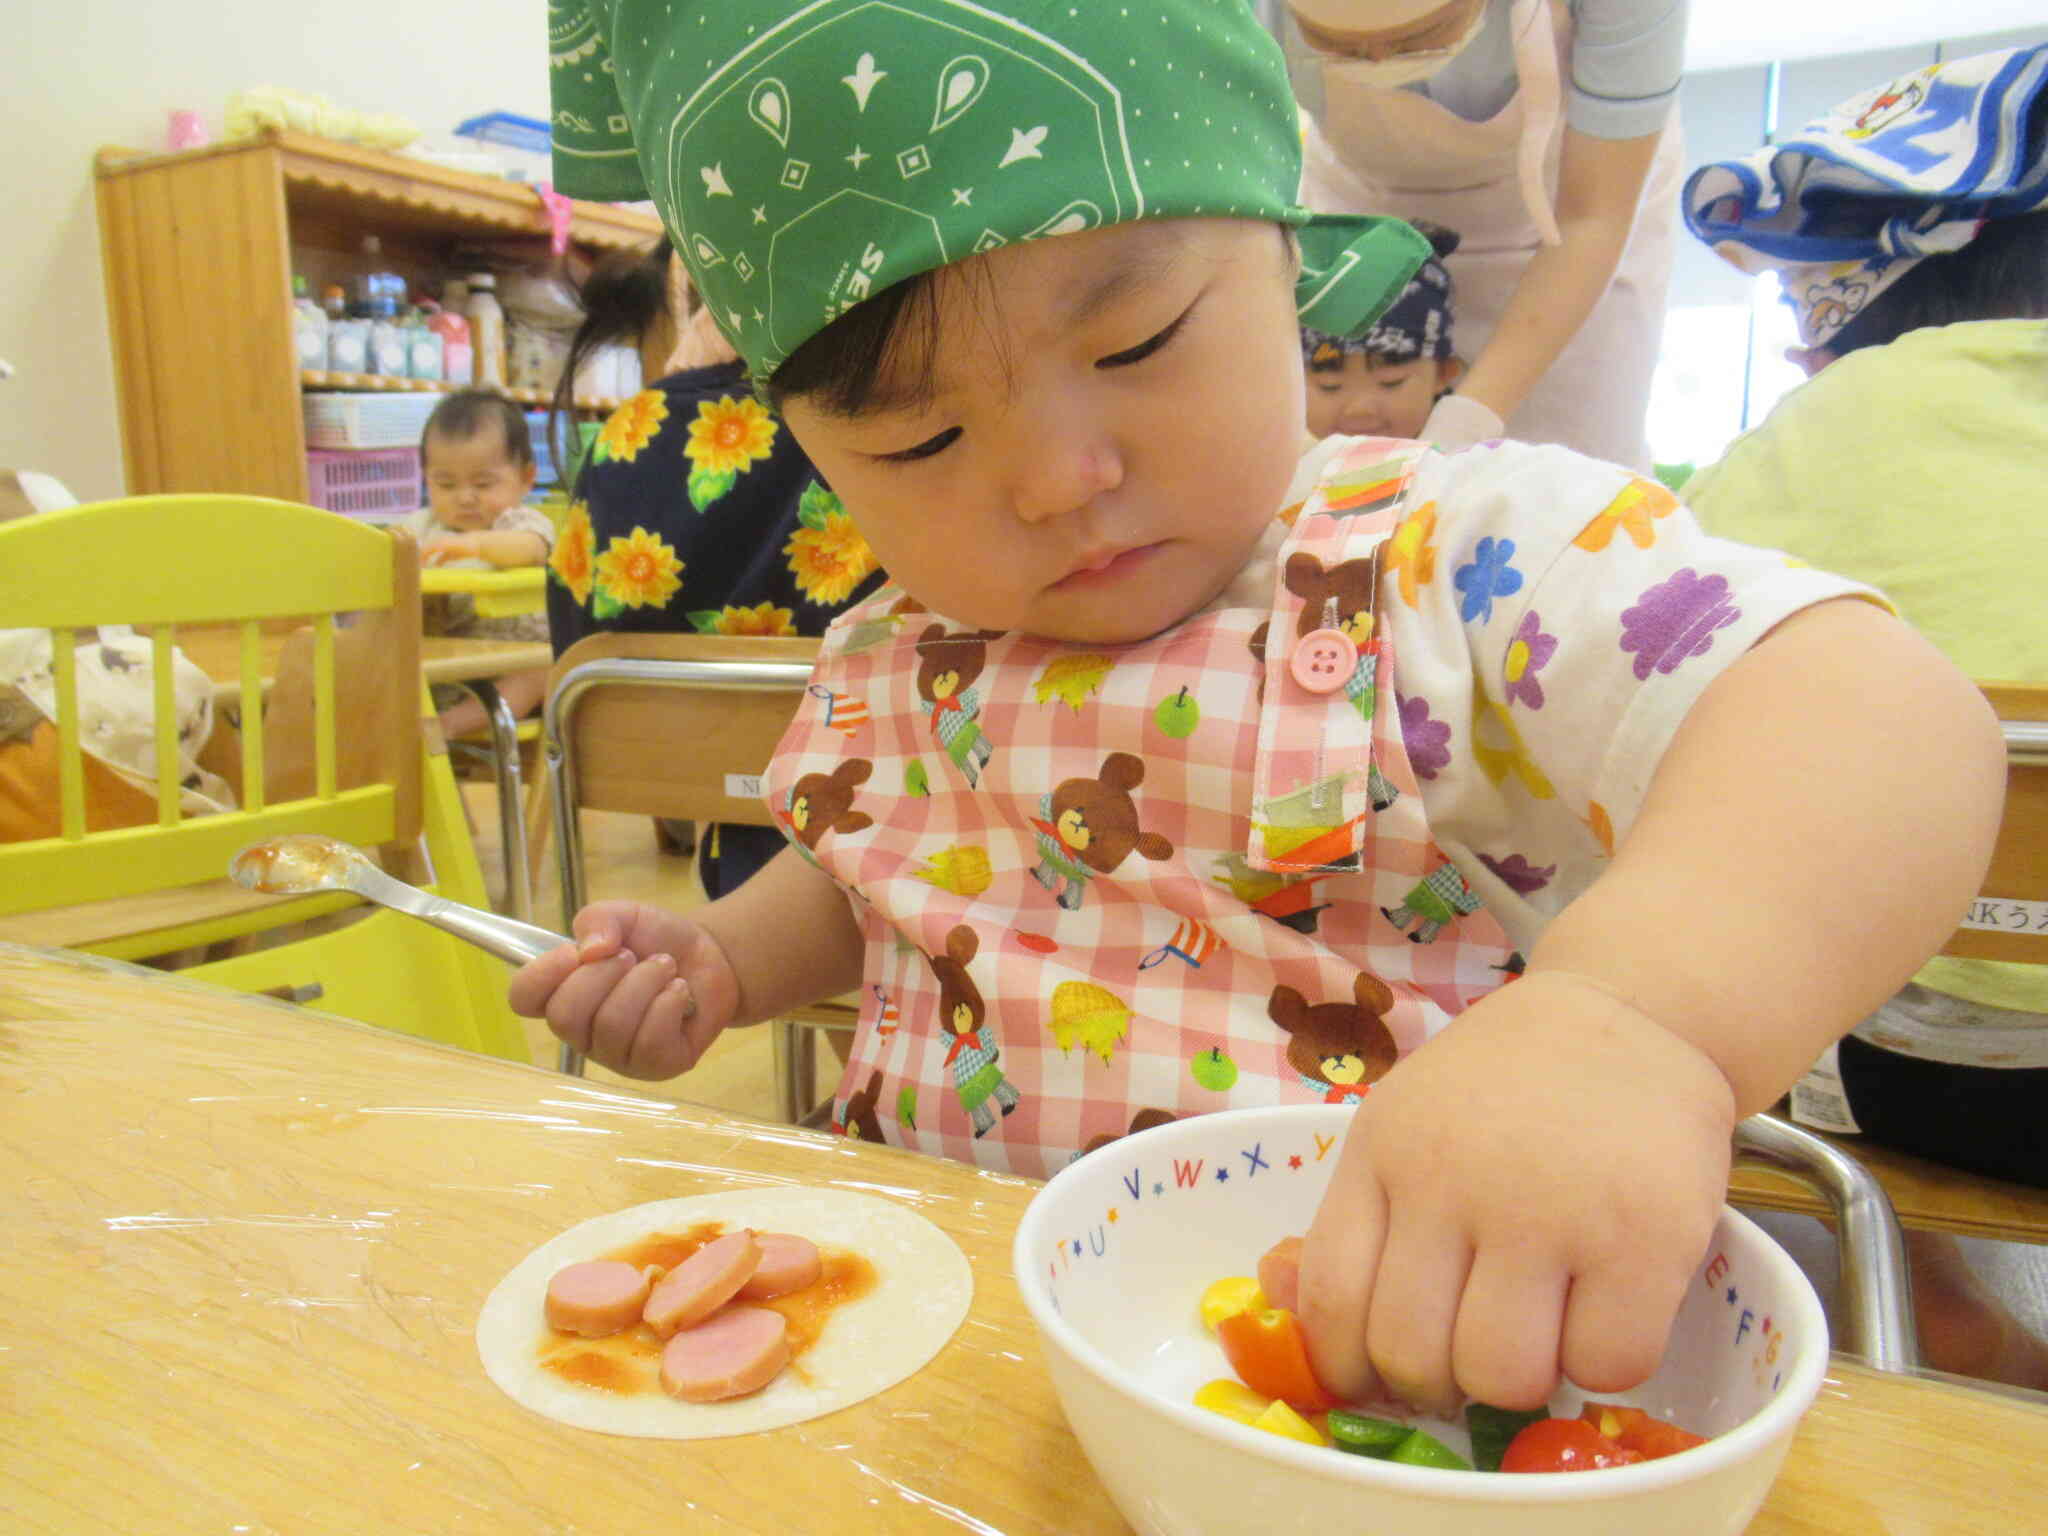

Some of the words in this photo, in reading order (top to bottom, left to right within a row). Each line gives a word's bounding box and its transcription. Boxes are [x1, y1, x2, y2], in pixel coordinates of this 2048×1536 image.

[1088, 1224, 1105, 1257] U
[1122, 1166, 1141, 1201] V
[1172, 1158, 1204, 1190] W
[1240, 1141, 1271, 1178] X
[1704, 1252, 1729, 1289] E
[1734, 1308, 1755, 1345] F
